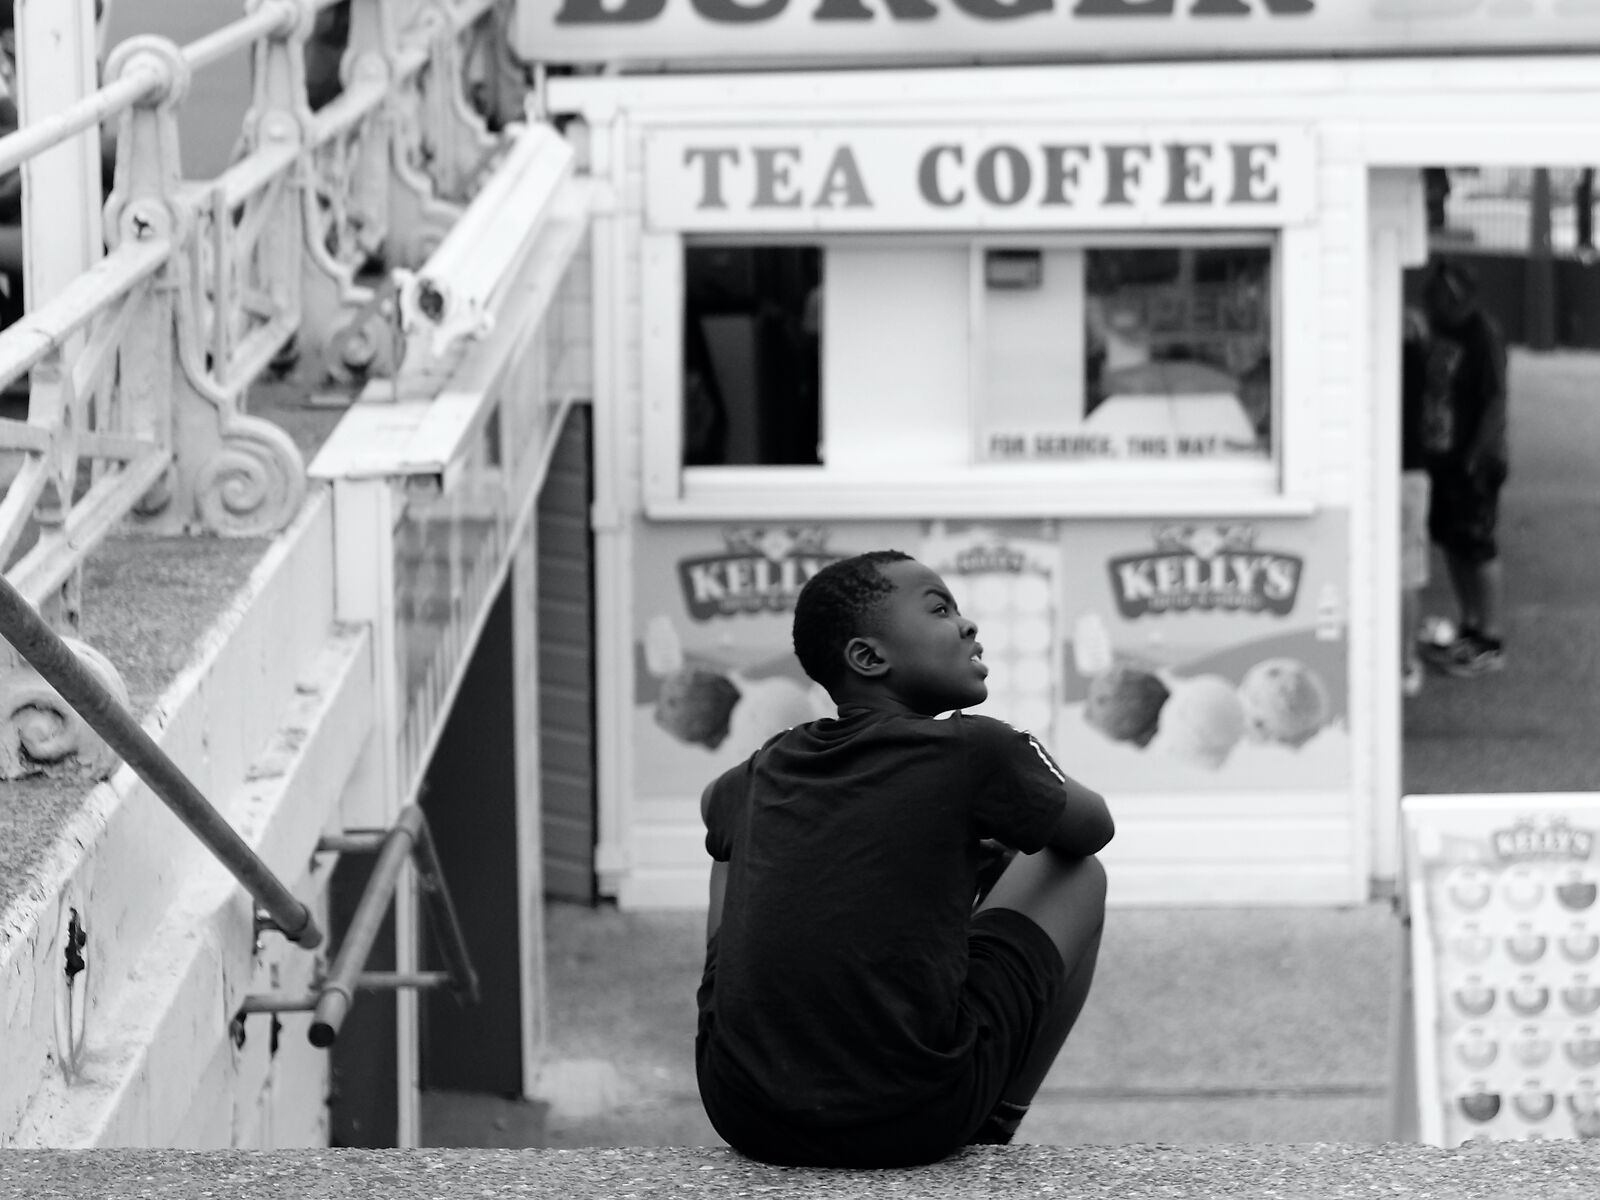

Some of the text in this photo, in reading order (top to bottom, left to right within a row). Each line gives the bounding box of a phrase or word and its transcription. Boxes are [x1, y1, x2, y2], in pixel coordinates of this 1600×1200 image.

[683, 141, 1280, 211] TEA COFFEE
[1120, 555, 1295, 602] KELLY'S
